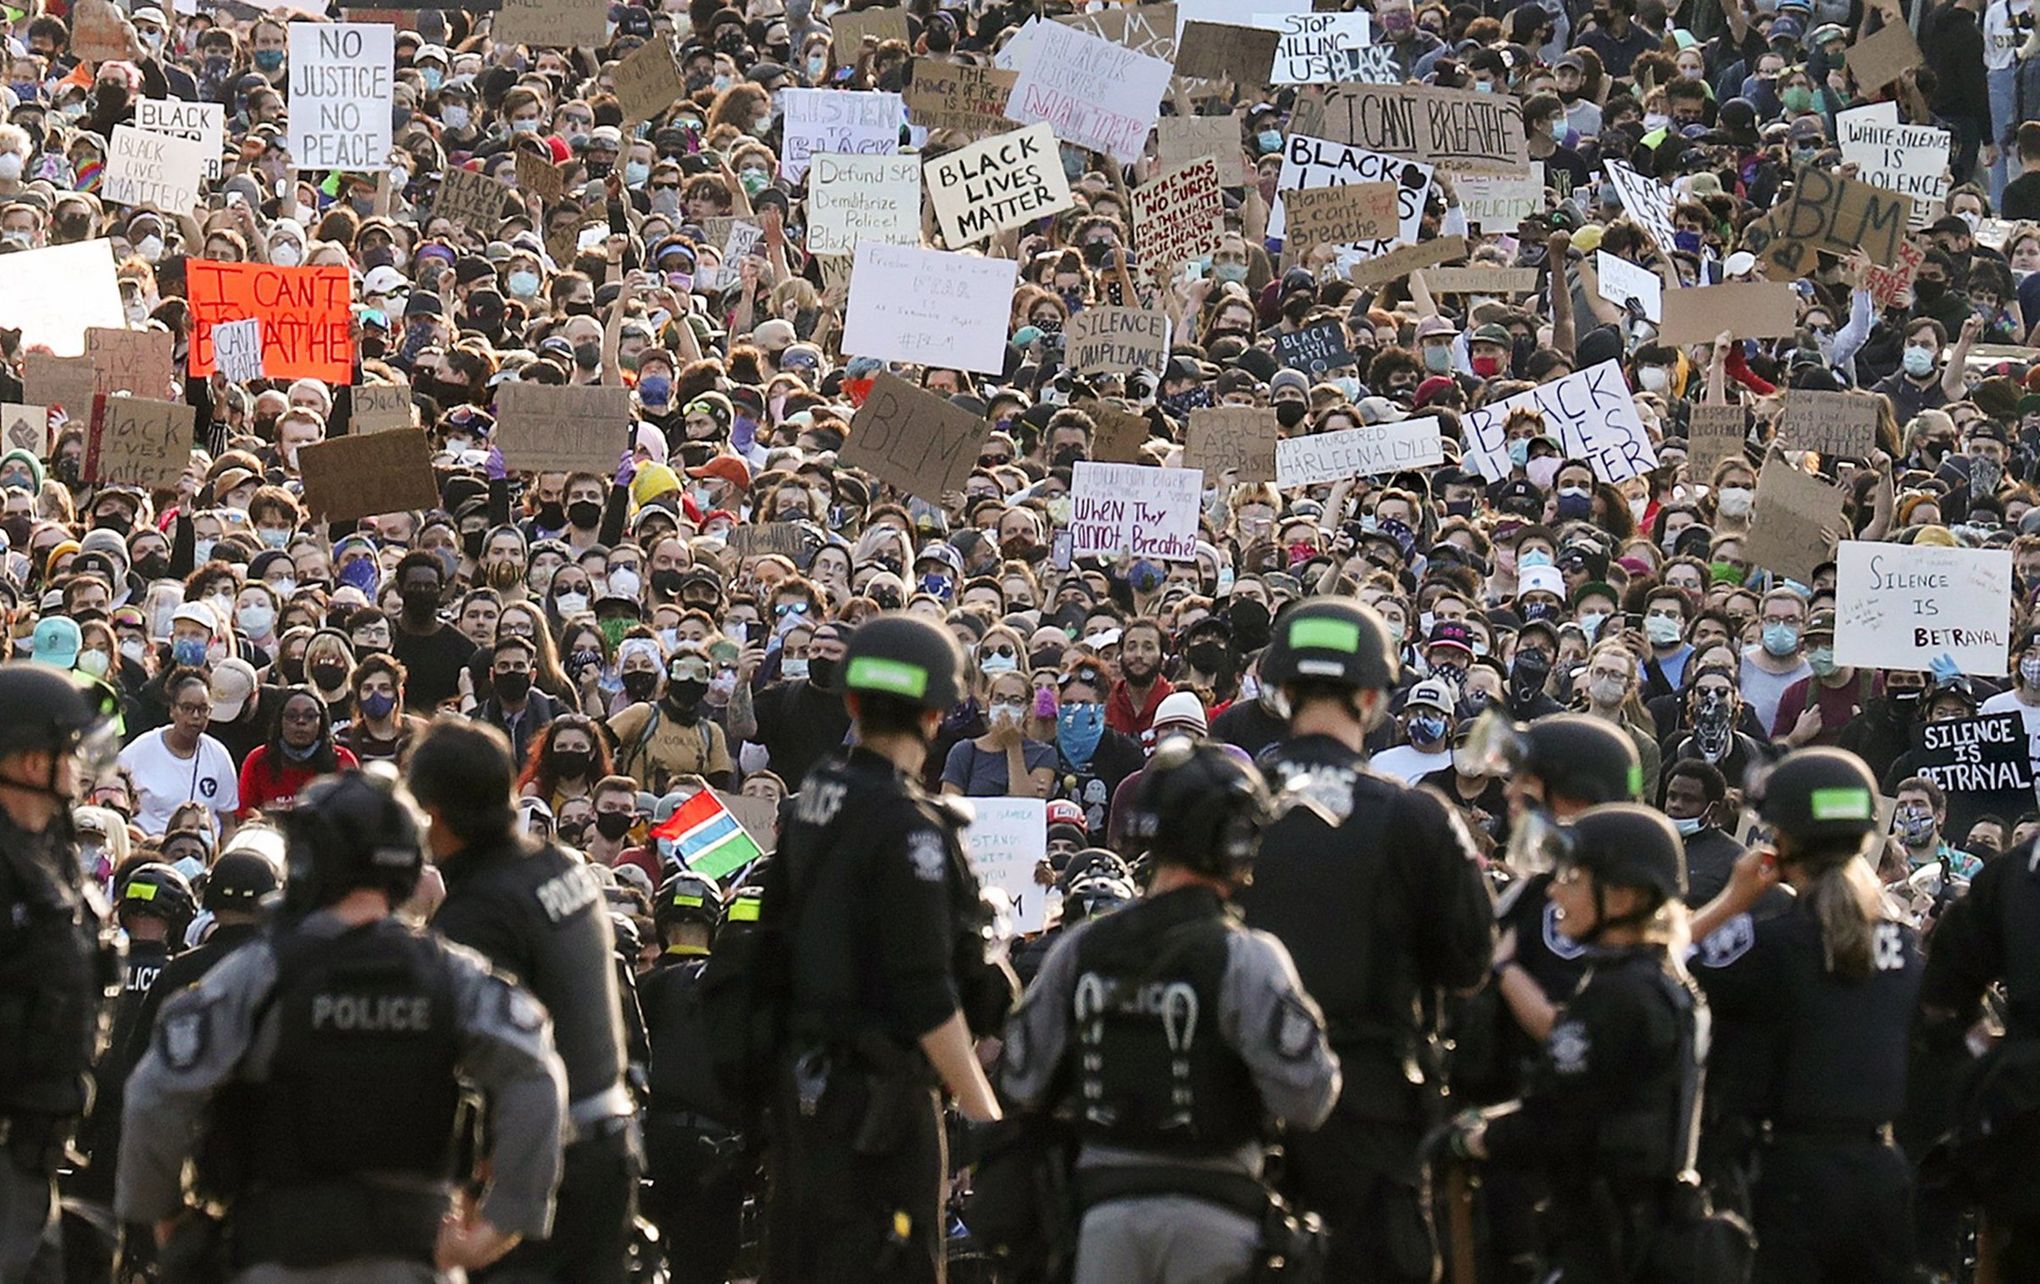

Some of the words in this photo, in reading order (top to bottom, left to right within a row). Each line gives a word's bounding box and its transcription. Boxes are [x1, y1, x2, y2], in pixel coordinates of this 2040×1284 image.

[1283, 15, 1336, 35] STOP
[320, 29, 362, 59] NO
[294, 65, 387, 99] JUSTICE
[956, 65, 988, 83] THE
[1290, 57, 1330, 81] US
[142, 104, 211, 129] BLACK
[320, 103, 361, 132] NO
[787, 92, 899, 129] LISTEN
[944, 99, 957, 110] IS
[827, 126, 853, 137] TO
[1023, 84, 1143, 156] MATTER
[119, 134, 166, 163] BLACK
[303, 134, 380, 167] PEACE
[1896, 129, 1950, 149] SILENCE
[125, 160, 164, 181] LIVES
[820, 159, 884, 184] Defund
[890, 164, 920, 183] SPD
[940, 136, 1039, 188] BLACK
[1290, 136, 1398, 182] BLACK
[1884, 148, 1905, 169] IS
[107, 175, 189, 212] MATTER
[445, 168, 509, 200] BLACK
[965, 164, 1042, 204] LIVES
[1132, 174, 1177, 208] THERE
[1180, 159, 1215, 180] WAS
[1145, 193, 1169, 218] NO
[1171, 171, 1220, 205] CURFEW
[1862, 170, 1943, 198] IOLENCE
[442, 187, 498, 216] LIVES
[957, 185, 1056, 238] MATTER
[1157, 210, 1178, 226] THE
[1180, 190, 1220, 219] WHITE
[1462, 199, 1537, 218] MPLICITY
[1787, 165, 1901, 267] BLM
[1287, 210, 1305, 226] I
[1290, 220, 1378, 247] Breathe
[196, 266, 243, 307] I
[254, 268, 349, 310] CAN'T
[1075, 311, 1161, 341] SILENCE
[1281, 326, 1333, 350] BLACK
[196, 318, 349, 366] BATHE
[1197, 410, 1274, 440] POLICE
[1469, 367, 1621, 454] BACK
[859, 392, 967, 491] BLM
[1314, 427, 1388, 449] MURDERED
[1279, 444, 1385, 478] HARLEENA
[1132, 525, 1197, 557] Breathe?
[1870, 554, 1950, 591] SILENCE
[1913, 599, 1939, 616] IS
[1914, 627, 2004, 648] BETRAYAL
[1924, 718, 2016, 750] SILENCE
[1953, 744, 1982, 763] IS
[980, 870, 1007, 885] YOU
[312, 995, 431, 1031] POLICE
